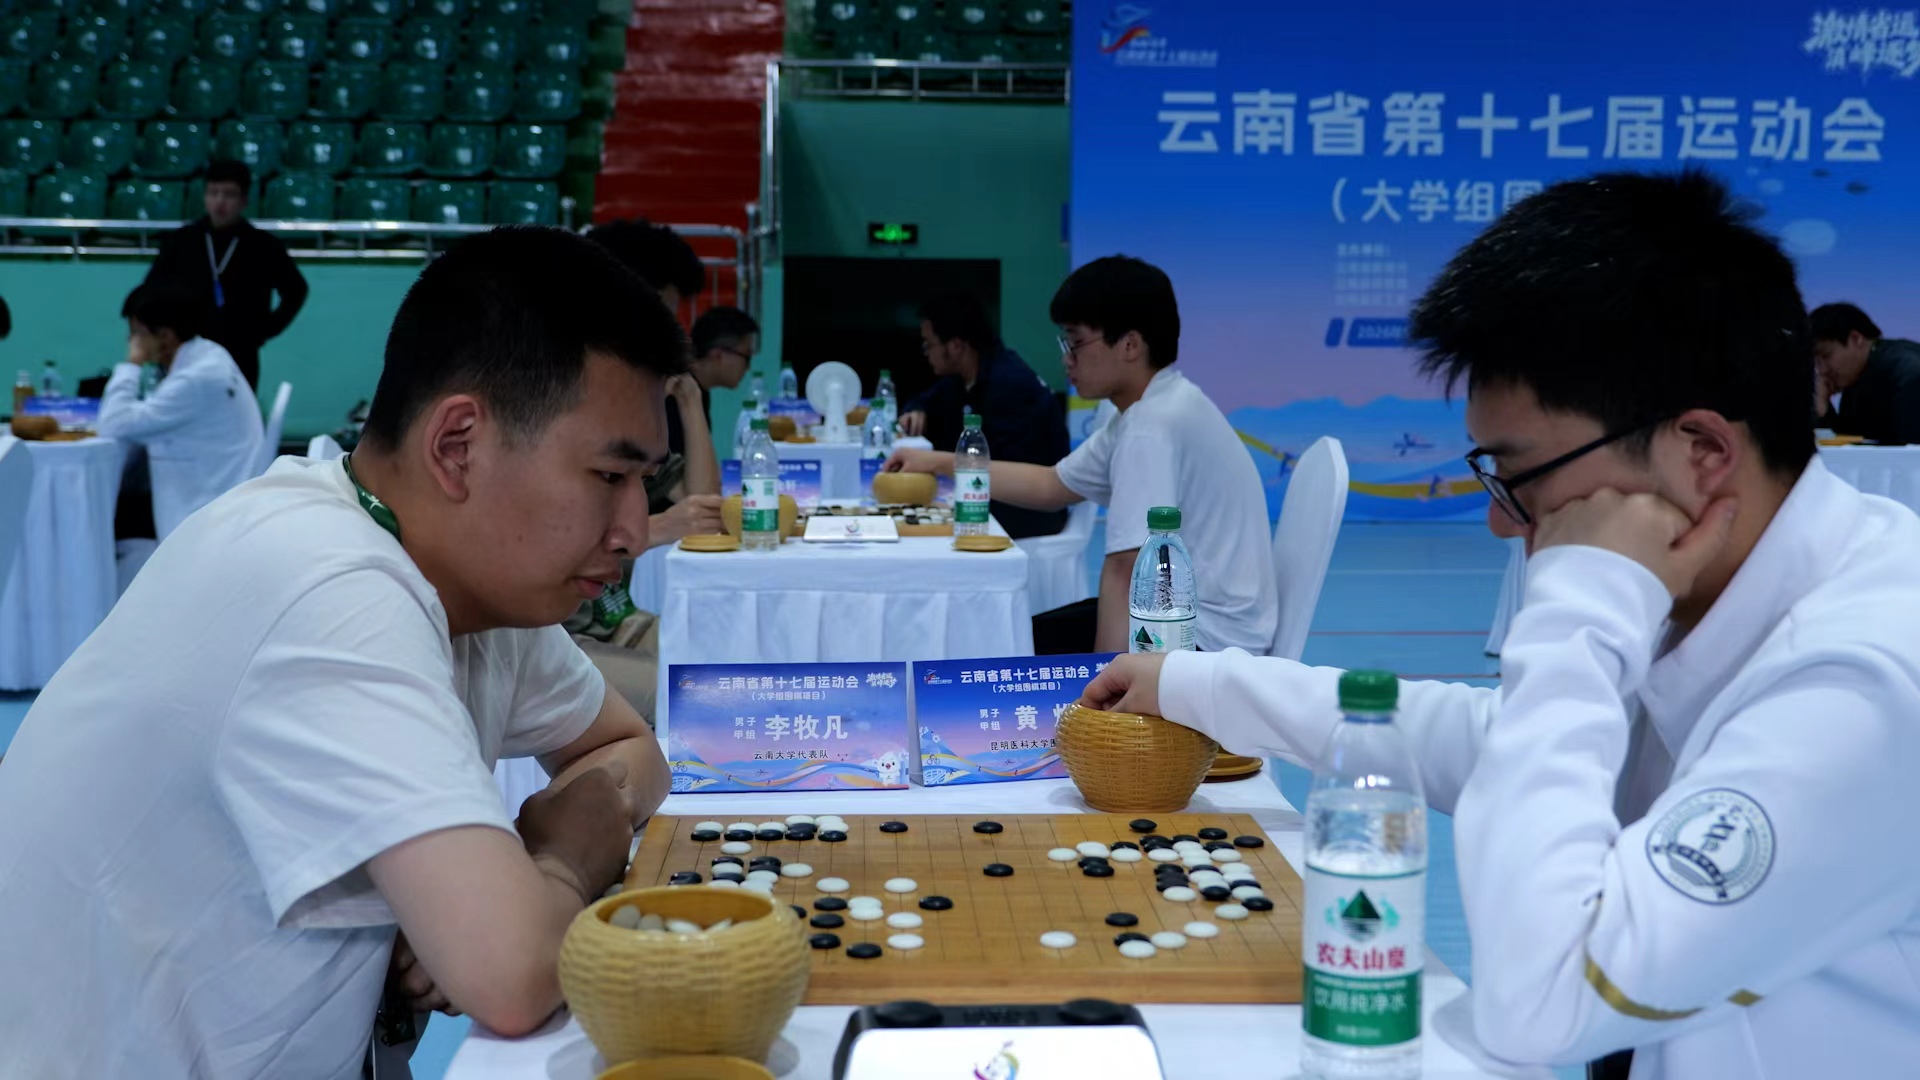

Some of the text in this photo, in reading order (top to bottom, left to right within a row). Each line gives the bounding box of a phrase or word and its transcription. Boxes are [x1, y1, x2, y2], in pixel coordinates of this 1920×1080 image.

[1158, 89, 1885, 161] 云南省第十七届运动会
[960, 666, 1090, 684] 云南省第十七届运动会
[717, 676, 859, 690] 云南省第十七届运动会
[979, 708, 1000, 718] 男子
[735, 717, 757, 727] 男子
[764, 714, 848, 741] 李牧凡
[979, 721, 1001, 731] 甲组
[734, 730, 756, 740] 甲组
[753, 750, 829, 760] 云南大学代表队
[1317, 942, 1406, 970] 农夫山泉
